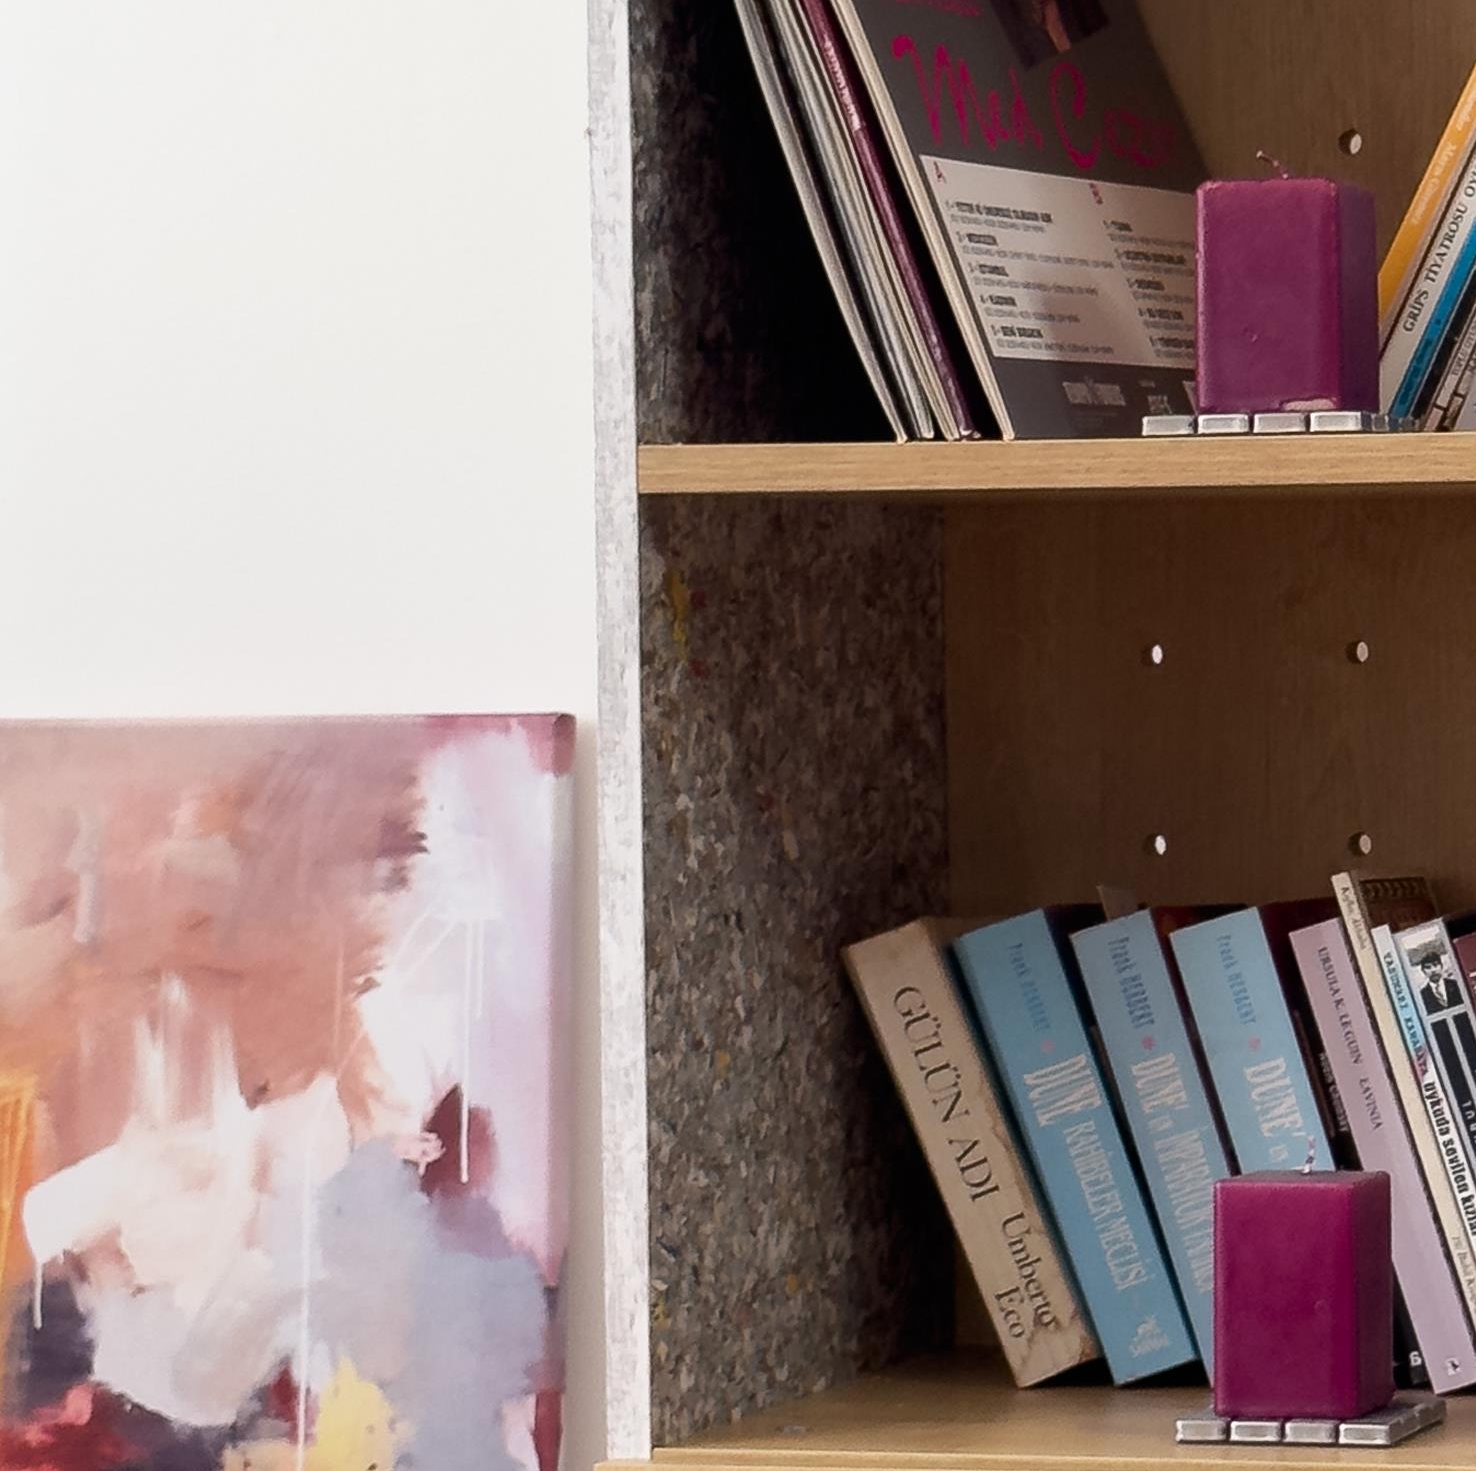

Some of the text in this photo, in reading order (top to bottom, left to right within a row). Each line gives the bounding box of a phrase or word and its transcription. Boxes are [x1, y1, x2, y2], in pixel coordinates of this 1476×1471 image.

[1398, 286, 1431, 333] GRİPS
[1420, 200, 1470, 285] TİYATROSU
[1315, 945, 1342, 997] URSULA
[893, 986, 1000, 1202] GÜLÜN ADI
[1023, 1052, 1103, 1128] DUNE
[1420, 1080, 1453, 1138] uykuda
[1440, 1136, 1472, 1194] sevilen
[993, 1285, 1026, 1339] Eco
[1001, 1212, 1060, 1329] Umberto
